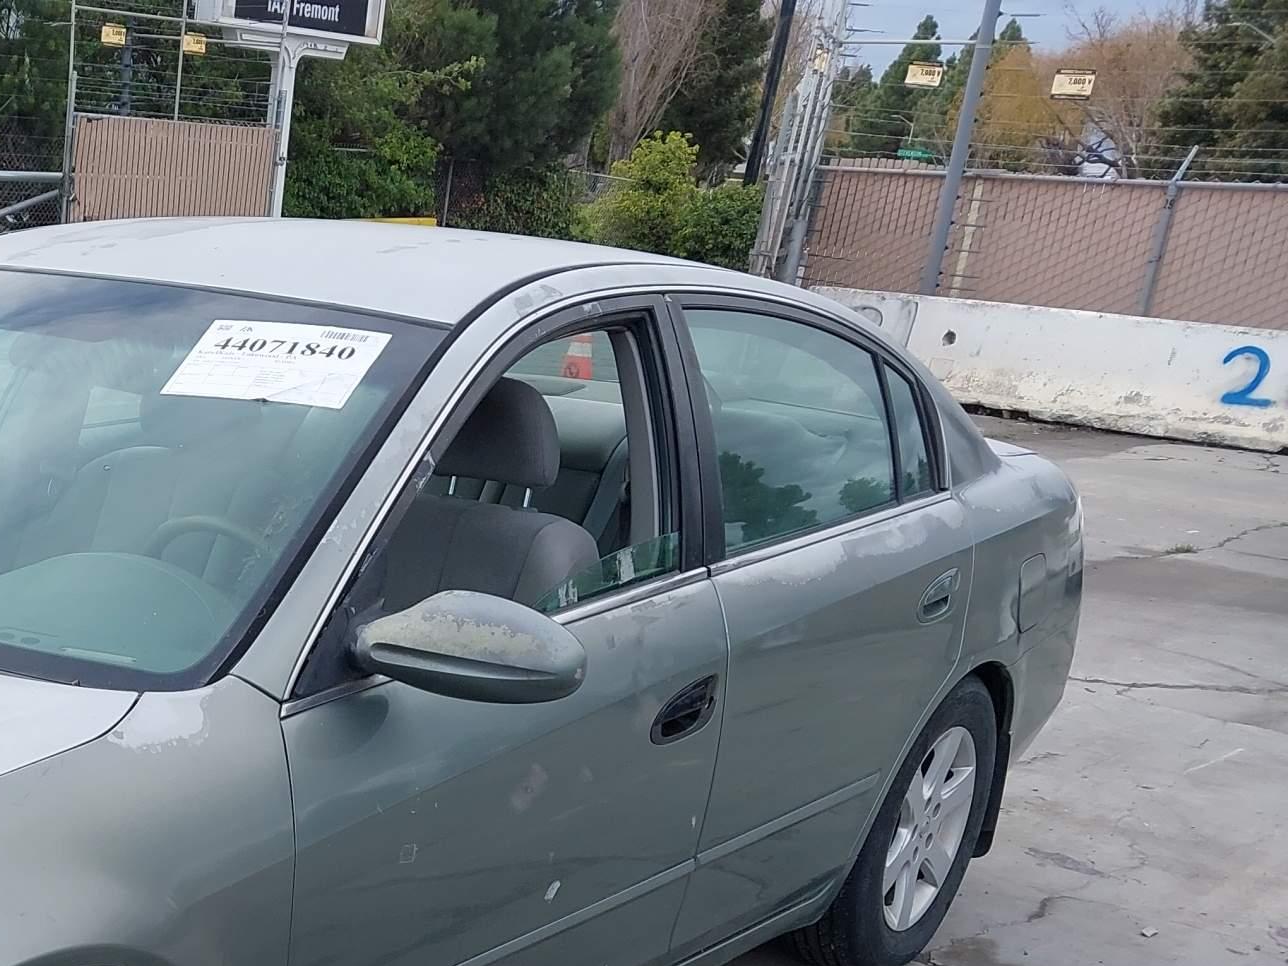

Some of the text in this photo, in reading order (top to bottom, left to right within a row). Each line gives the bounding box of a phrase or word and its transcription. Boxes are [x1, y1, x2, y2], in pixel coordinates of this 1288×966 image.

[293, 0, 340, 22] Fremont
[1068, 77, 1086, 85] 7,000
[214, 336, 357, 360] 44071840
[1221, 346, 1273, 407] 2
